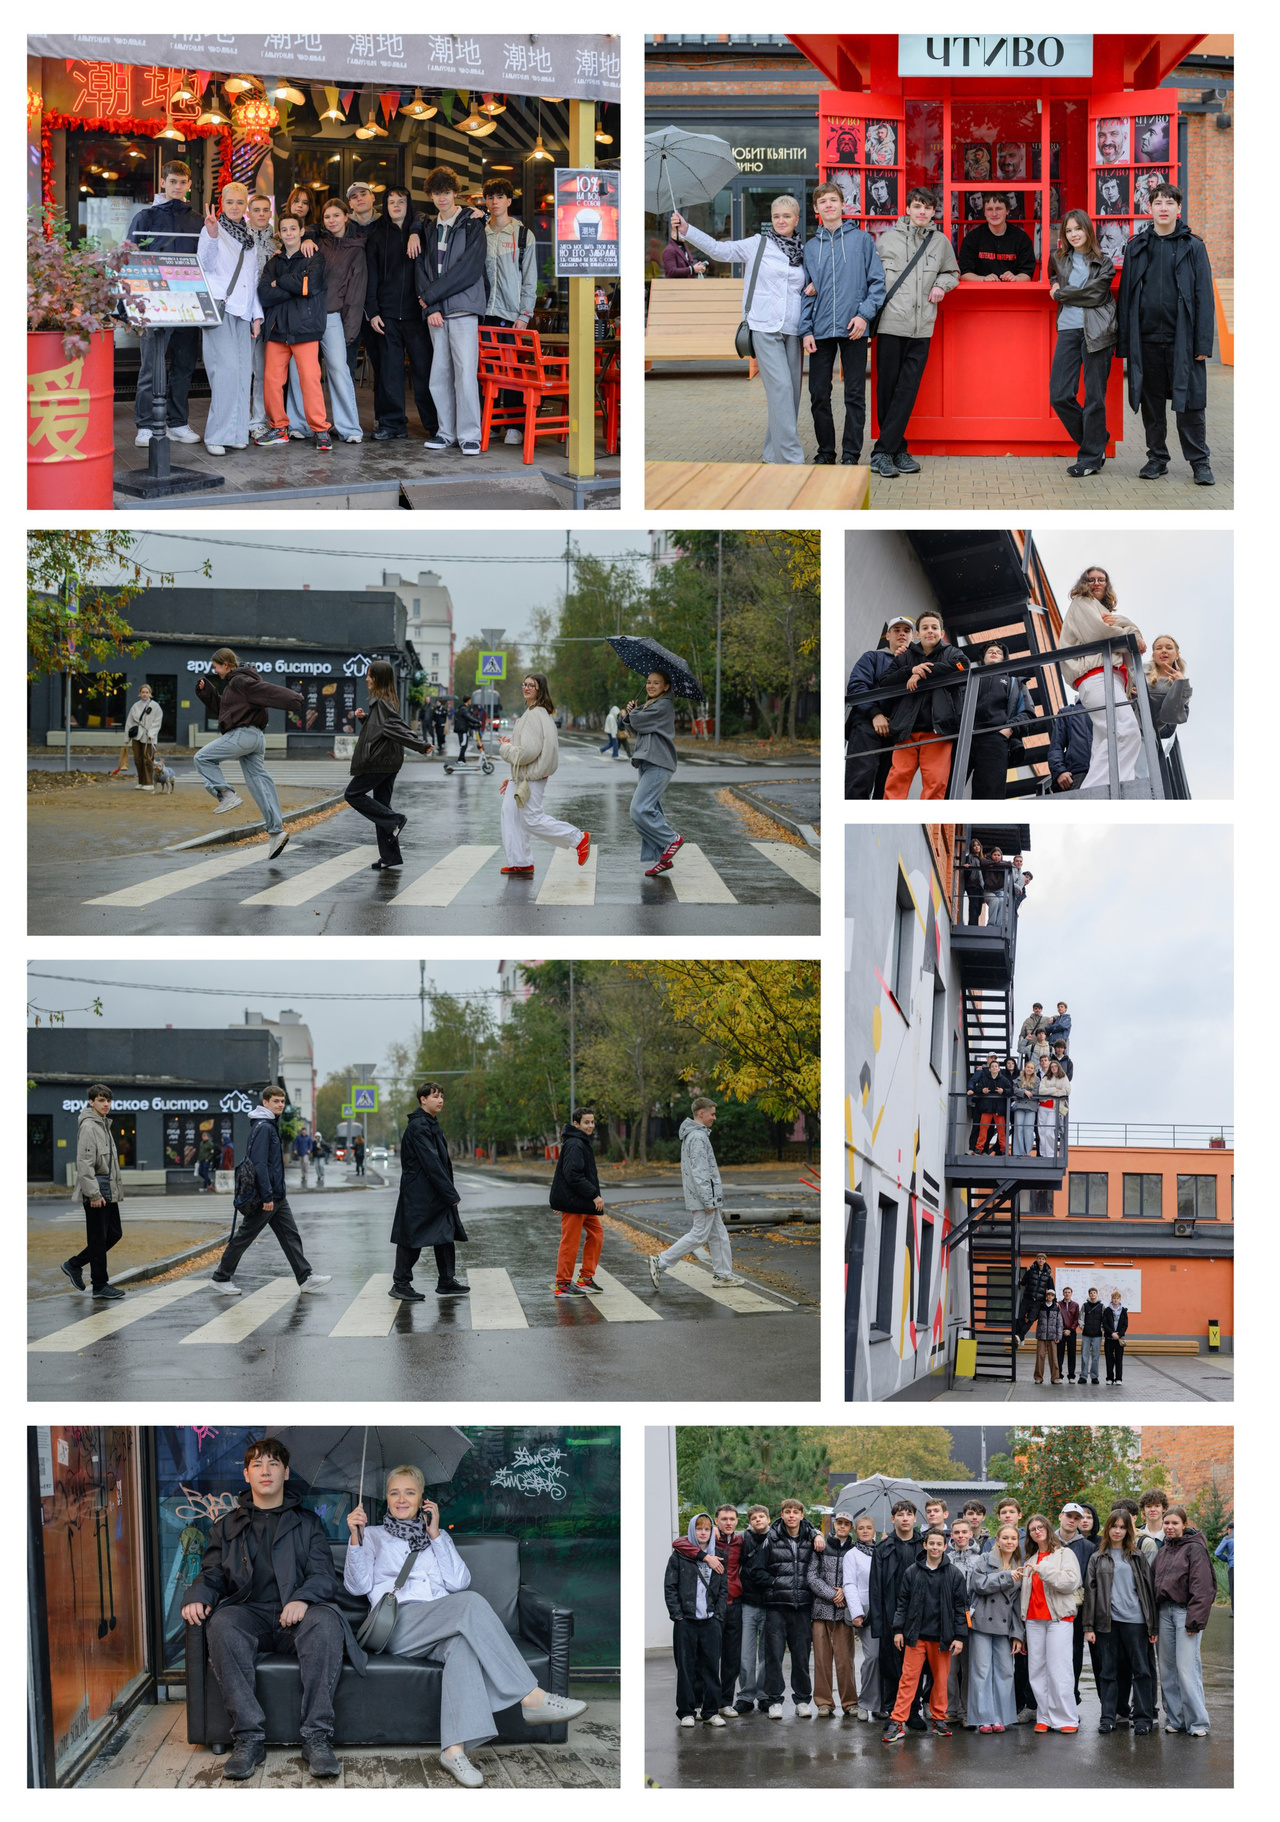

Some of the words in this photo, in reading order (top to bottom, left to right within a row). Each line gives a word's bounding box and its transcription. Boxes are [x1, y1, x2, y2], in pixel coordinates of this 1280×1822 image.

[348, 34, 404, 58] 潮地
[428, 35, 481, 65] 潮地
[503, 43, 552, 73] 潮地
[926, 37, 1064, 67] ЧТИВО
[575, 49, 620, 79] 潮地
[73, 60, 202, 119] 潮地
[732, 147, 766, 159] ЮБИТ
[767, 147, 807, 159] КЬЯНТИ
[576, 176, 600, 192] 10%
[27, 357, 90, 463] 爱
[187, 660, 272, 675] груое
[275, 660, 332, 676] бистро
[343, 663, 370, 677] YU
[62, 1098, 149, 1113] груское
[152, 1097, 208, 1112] бистро
[219, 1099, 251, 1113] YUG
